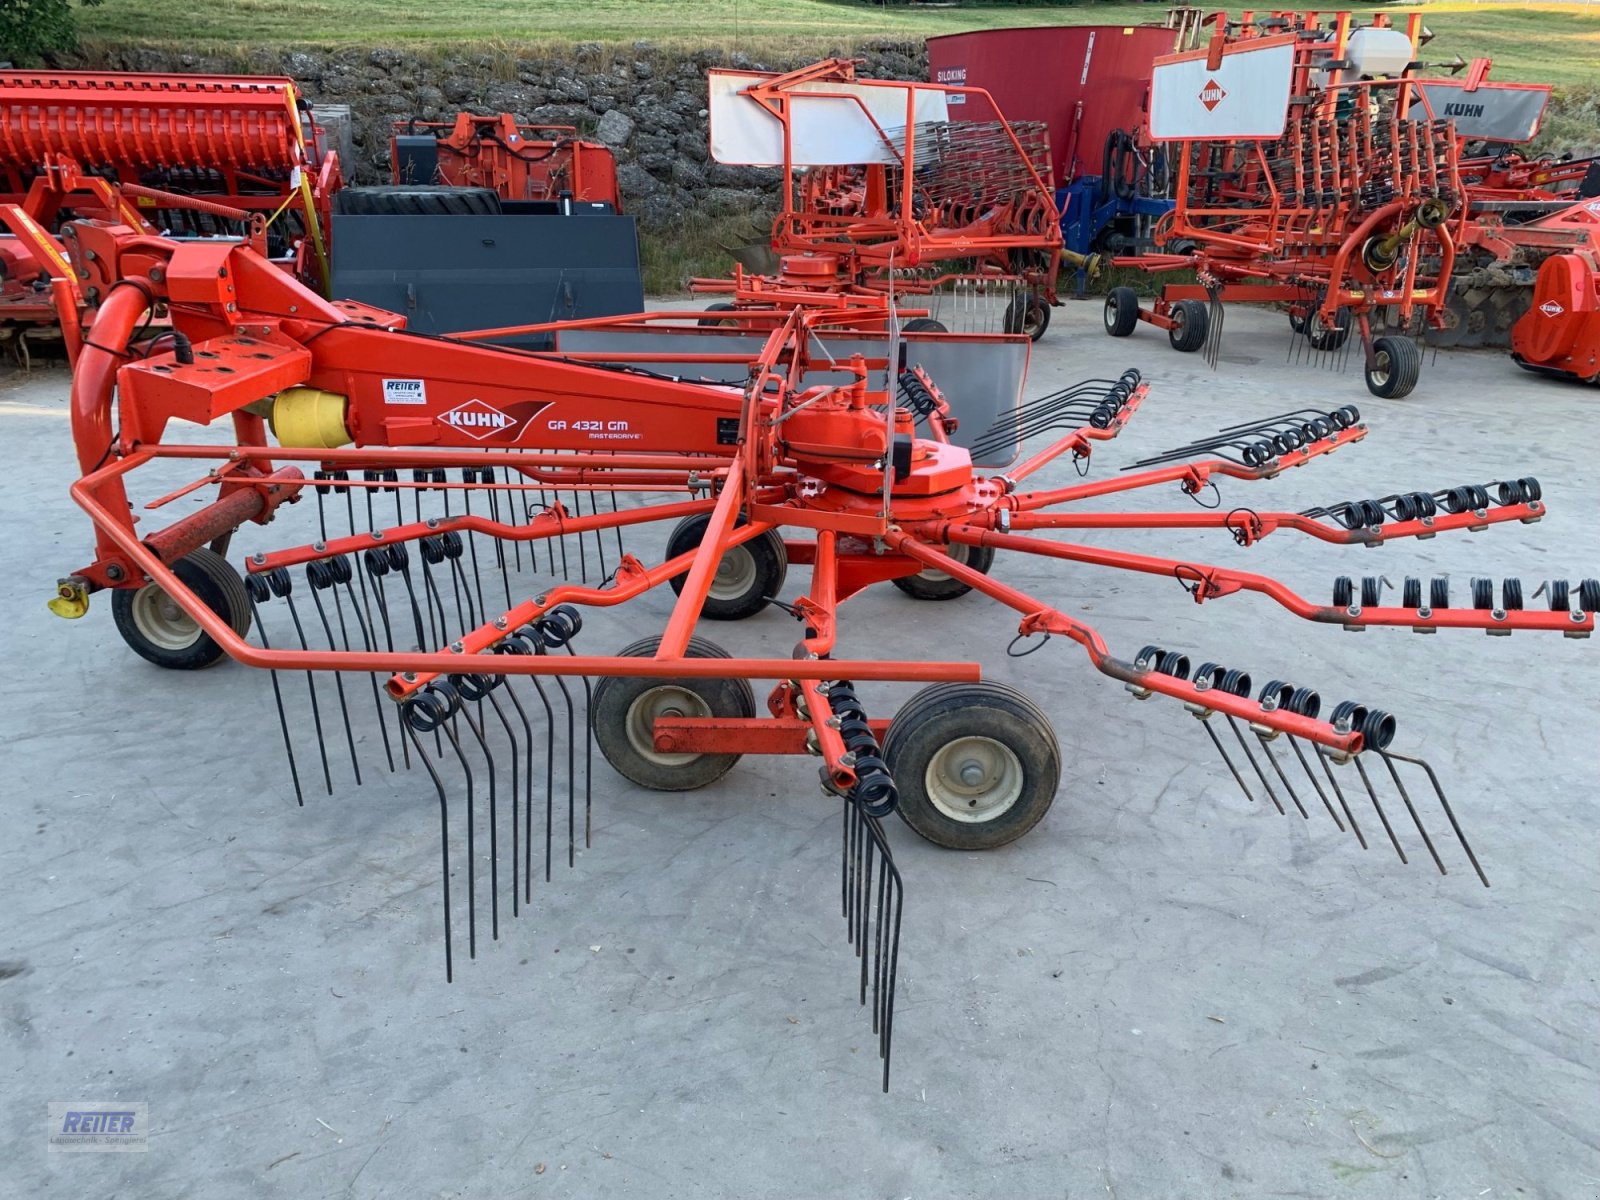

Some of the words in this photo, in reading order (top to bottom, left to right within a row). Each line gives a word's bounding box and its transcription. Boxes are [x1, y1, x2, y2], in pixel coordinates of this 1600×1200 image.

[937, 69, 966, 81] SILOKING
[1201, 89, 1223, 101] KUHN
[1443, 102, 1484, 117] KUHN
[386, 381, 420, 390] REITER
[449, 411, 506, 428] KUHN
[548, 420, 567, 430] GA
[571, 421, 603, 431] 4321
[607, 421, 629, 431] GM
